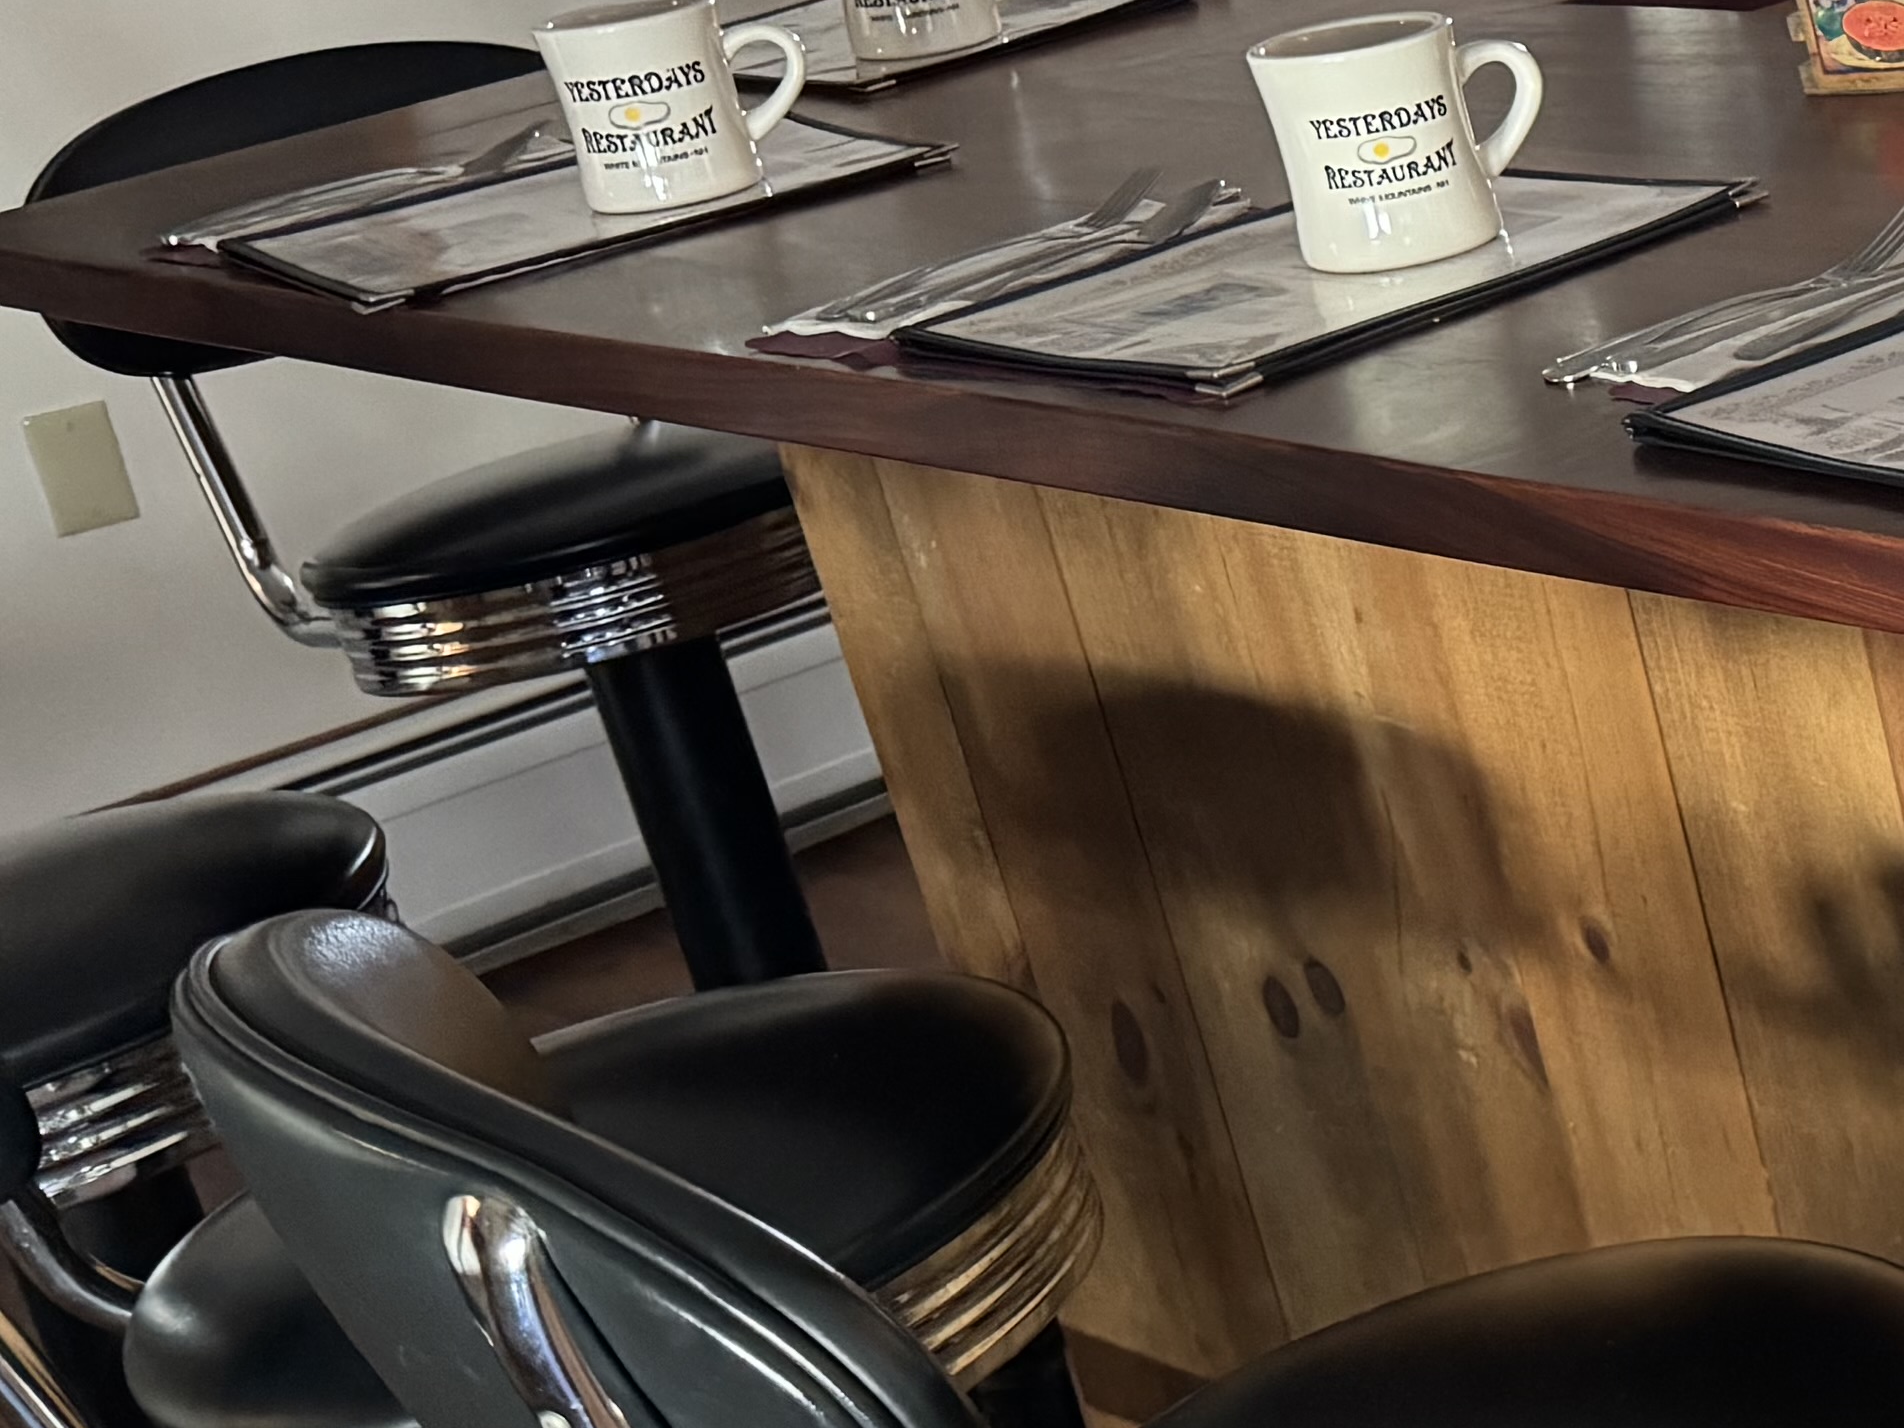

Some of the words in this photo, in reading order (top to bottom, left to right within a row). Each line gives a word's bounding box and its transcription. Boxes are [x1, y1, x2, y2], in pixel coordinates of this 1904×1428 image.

[564, 60, 705, 103] YESTERDAYS
[581, 104, 717, 154] RESTAURANT
[1309, 94, 1447, 140] YESTERDAYS
[1324, 137, 1457, 190] RESTAURANT
